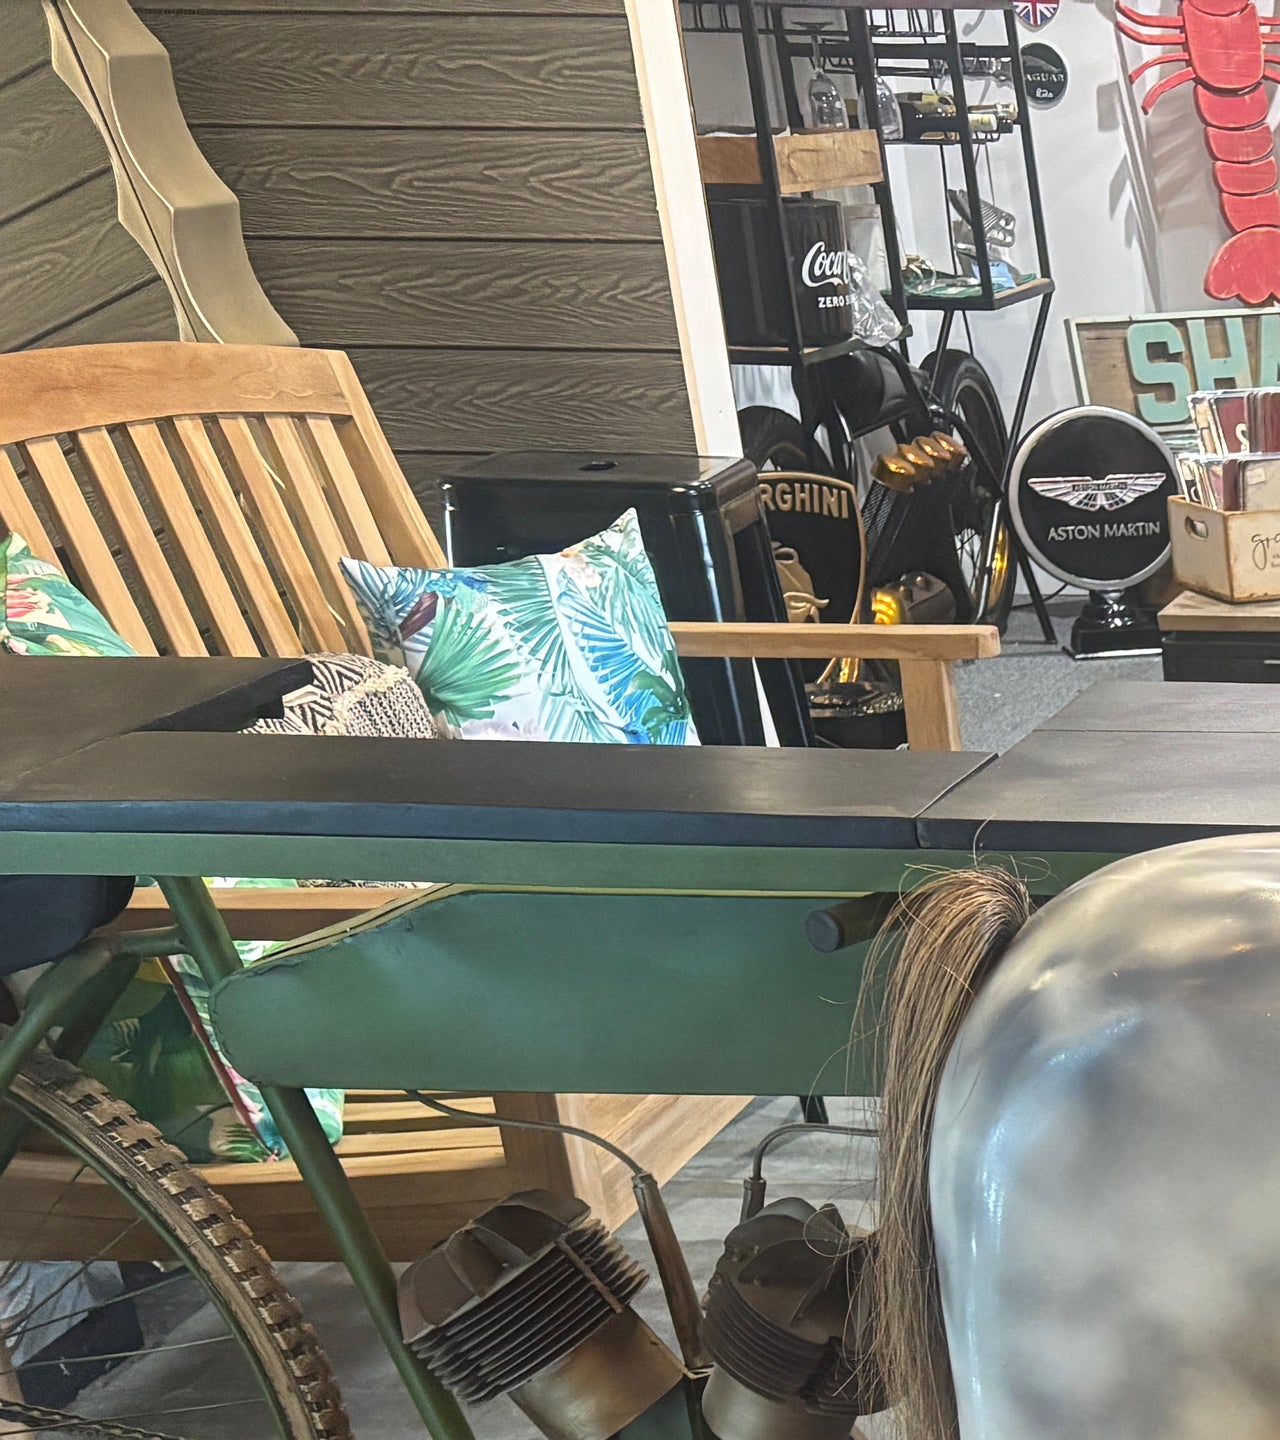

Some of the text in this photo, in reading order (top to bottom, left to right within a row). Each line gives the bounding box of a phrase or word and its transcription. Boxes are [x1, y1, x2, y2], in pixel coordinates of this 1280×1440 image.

[1024, 72, 1065, 82] AGUAR
[817, 295, 845, 308] ZERO
[758, 483, 849, 519] RGHINI
[1048, 521, 1160, 541] ASTON MARTIN
